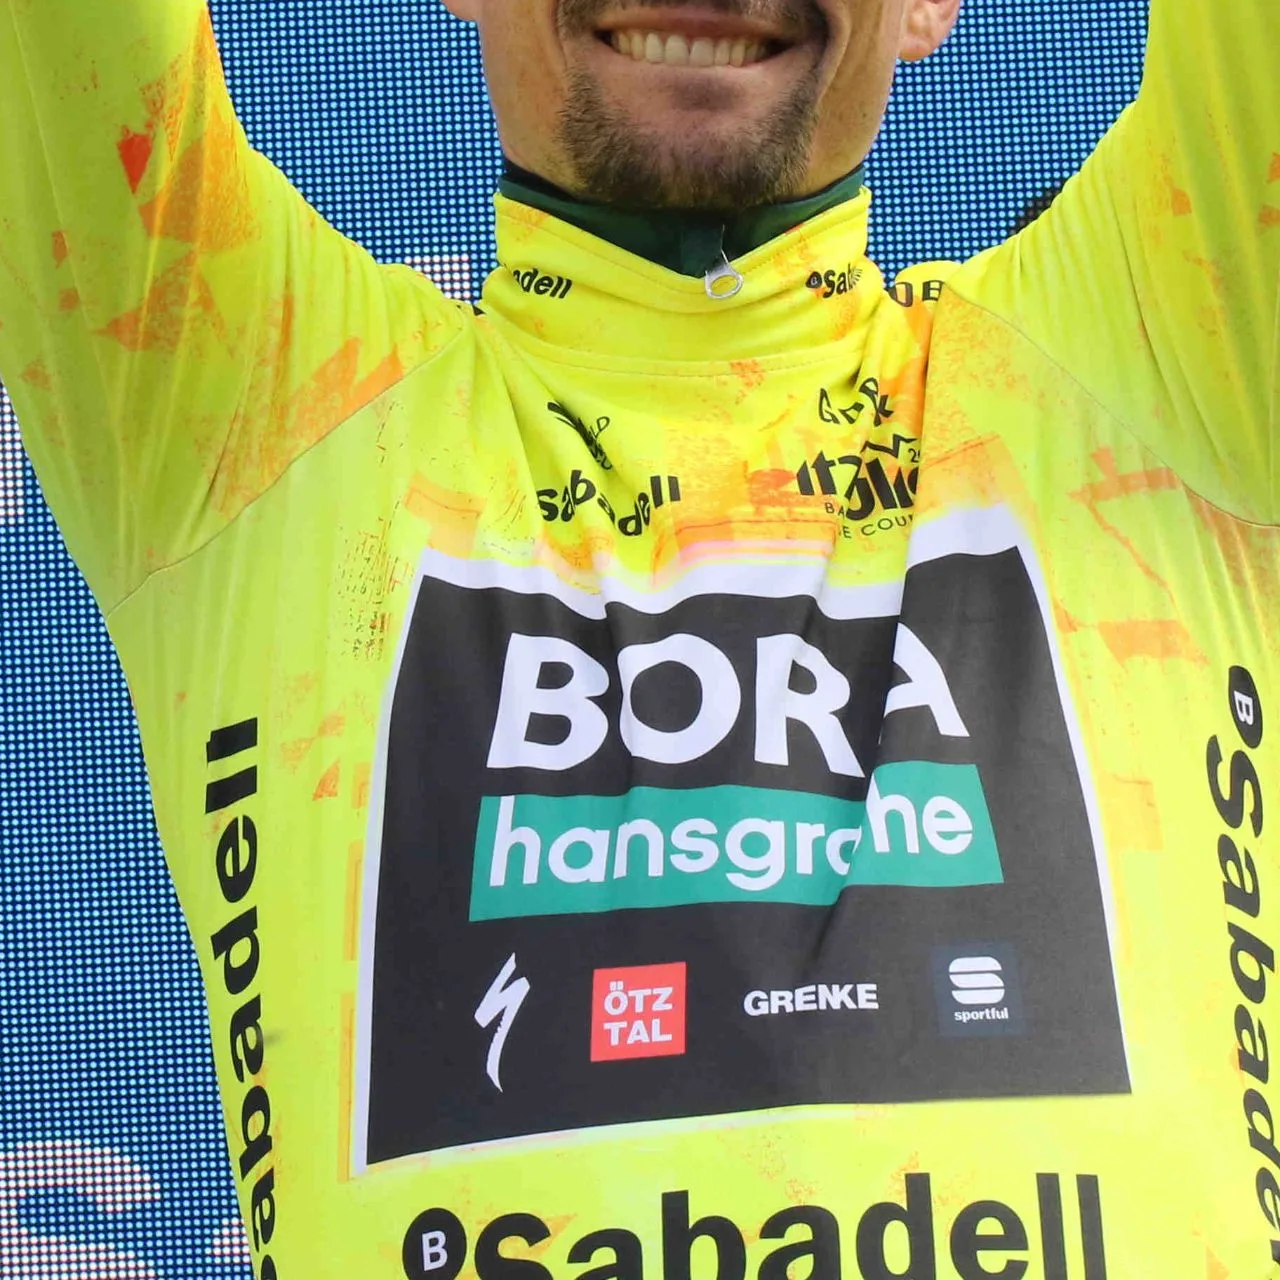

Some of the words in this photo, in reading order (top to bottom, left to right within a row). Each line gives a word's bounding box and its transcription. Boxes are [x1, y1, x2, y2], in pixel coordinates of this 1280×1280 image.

[486, 632, 972, 779] BORA
[489, 779, 975, 892] hansgrohe
[204, 716, 277, 1280] abadell
[603, 980, 674, 1016] ÖTZ
[743, 982, 880, 1018] GRENKE
[953, 1006, 1010, 1024] sportful
[603, 1020, 673, 1047] TAL
